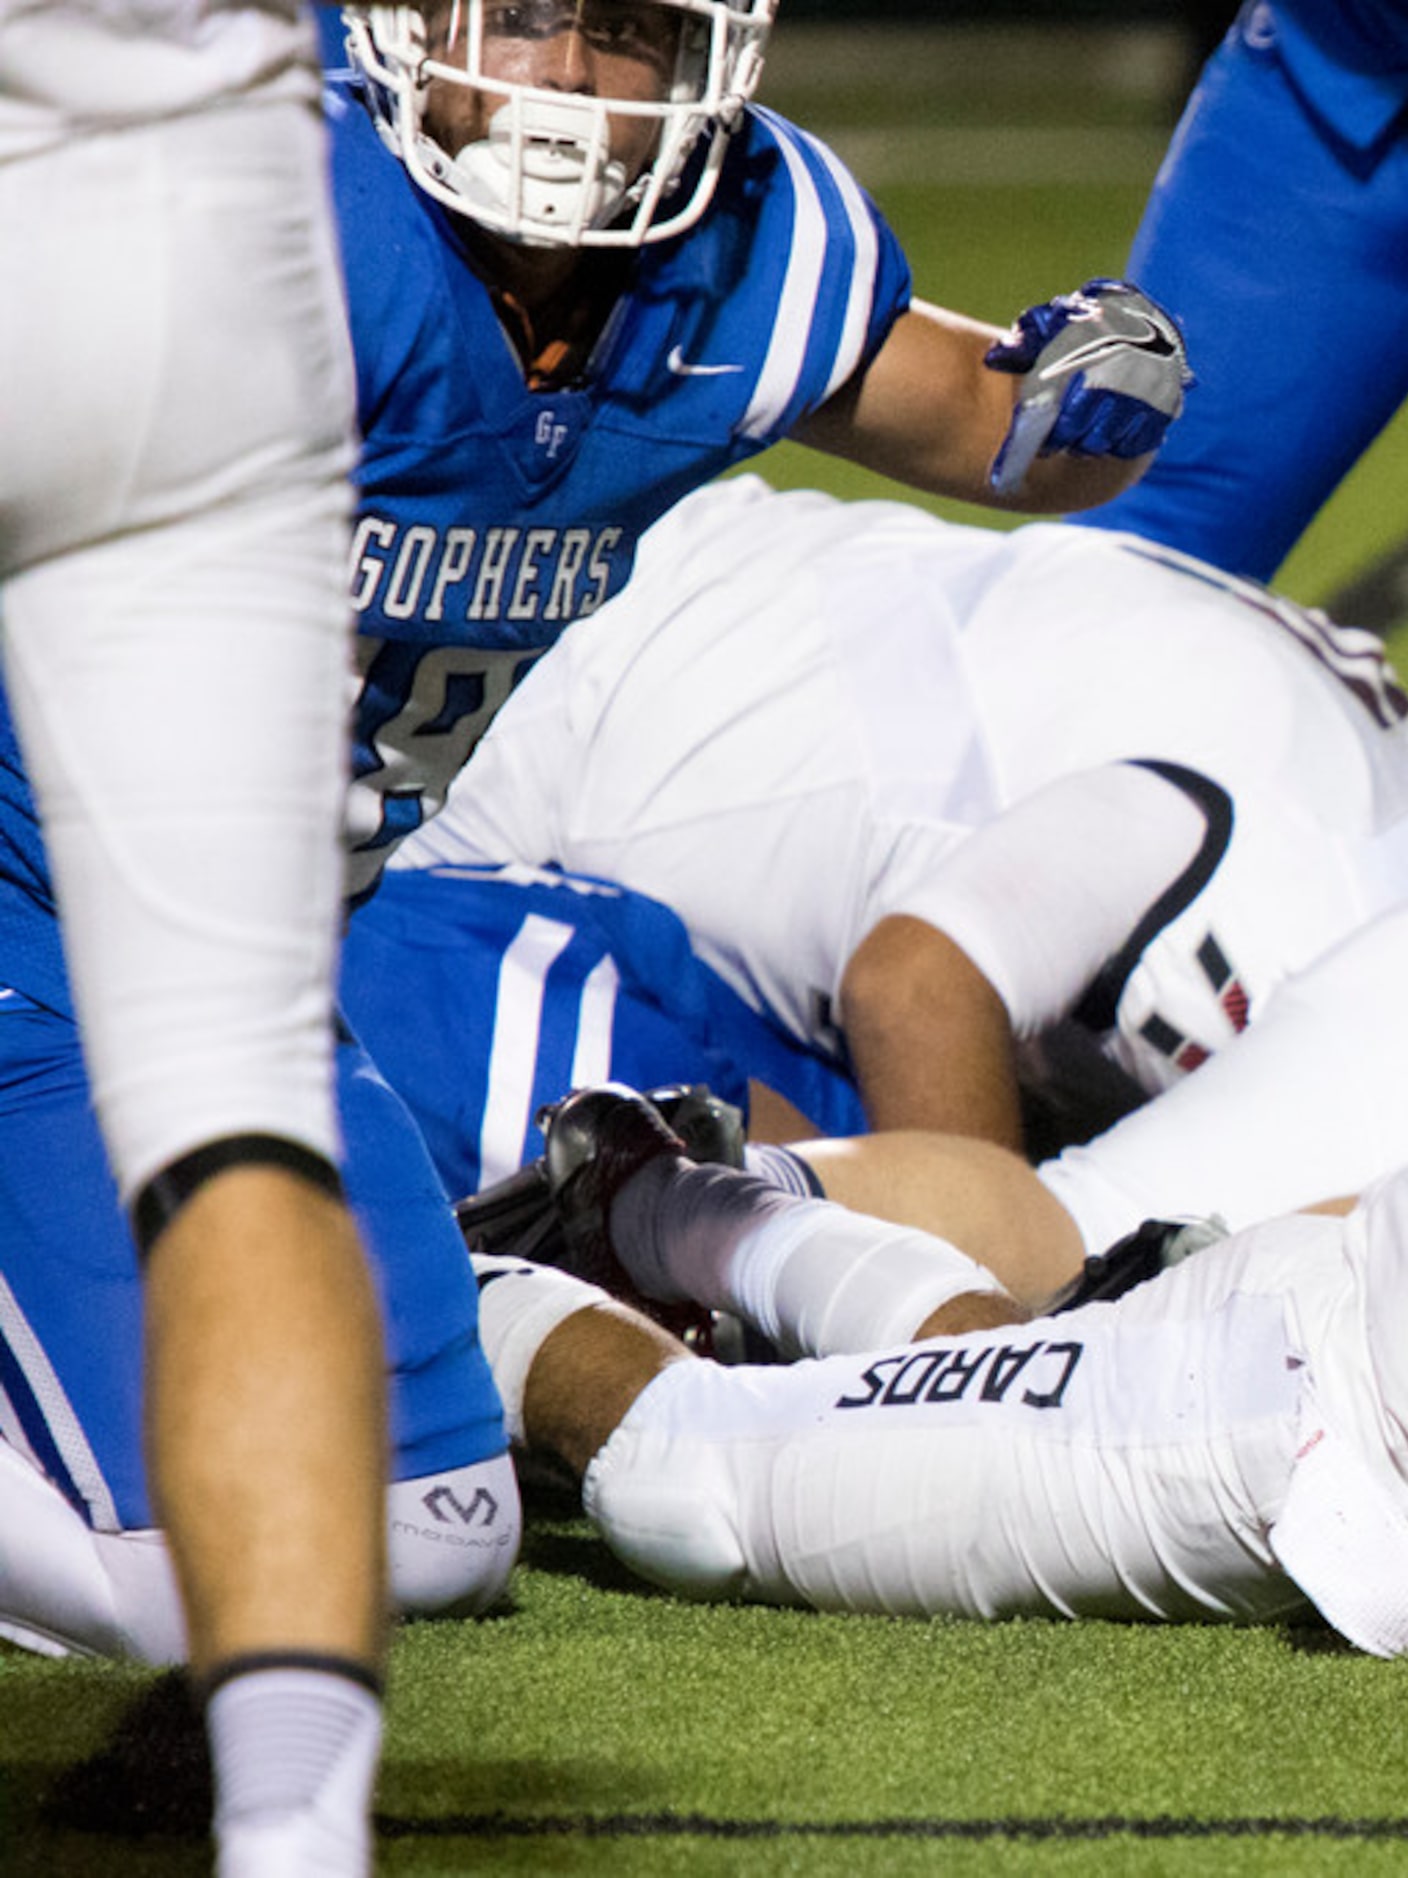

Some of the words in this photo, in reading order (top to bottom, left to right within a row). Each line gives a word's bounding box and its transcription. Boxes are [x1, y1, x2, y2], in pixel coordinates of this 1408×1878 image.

[535, 411, 567, 457] GF
[349, 516, 623, 621] GOPHERS
[835, 1341, 1085, 1409] CARDS
